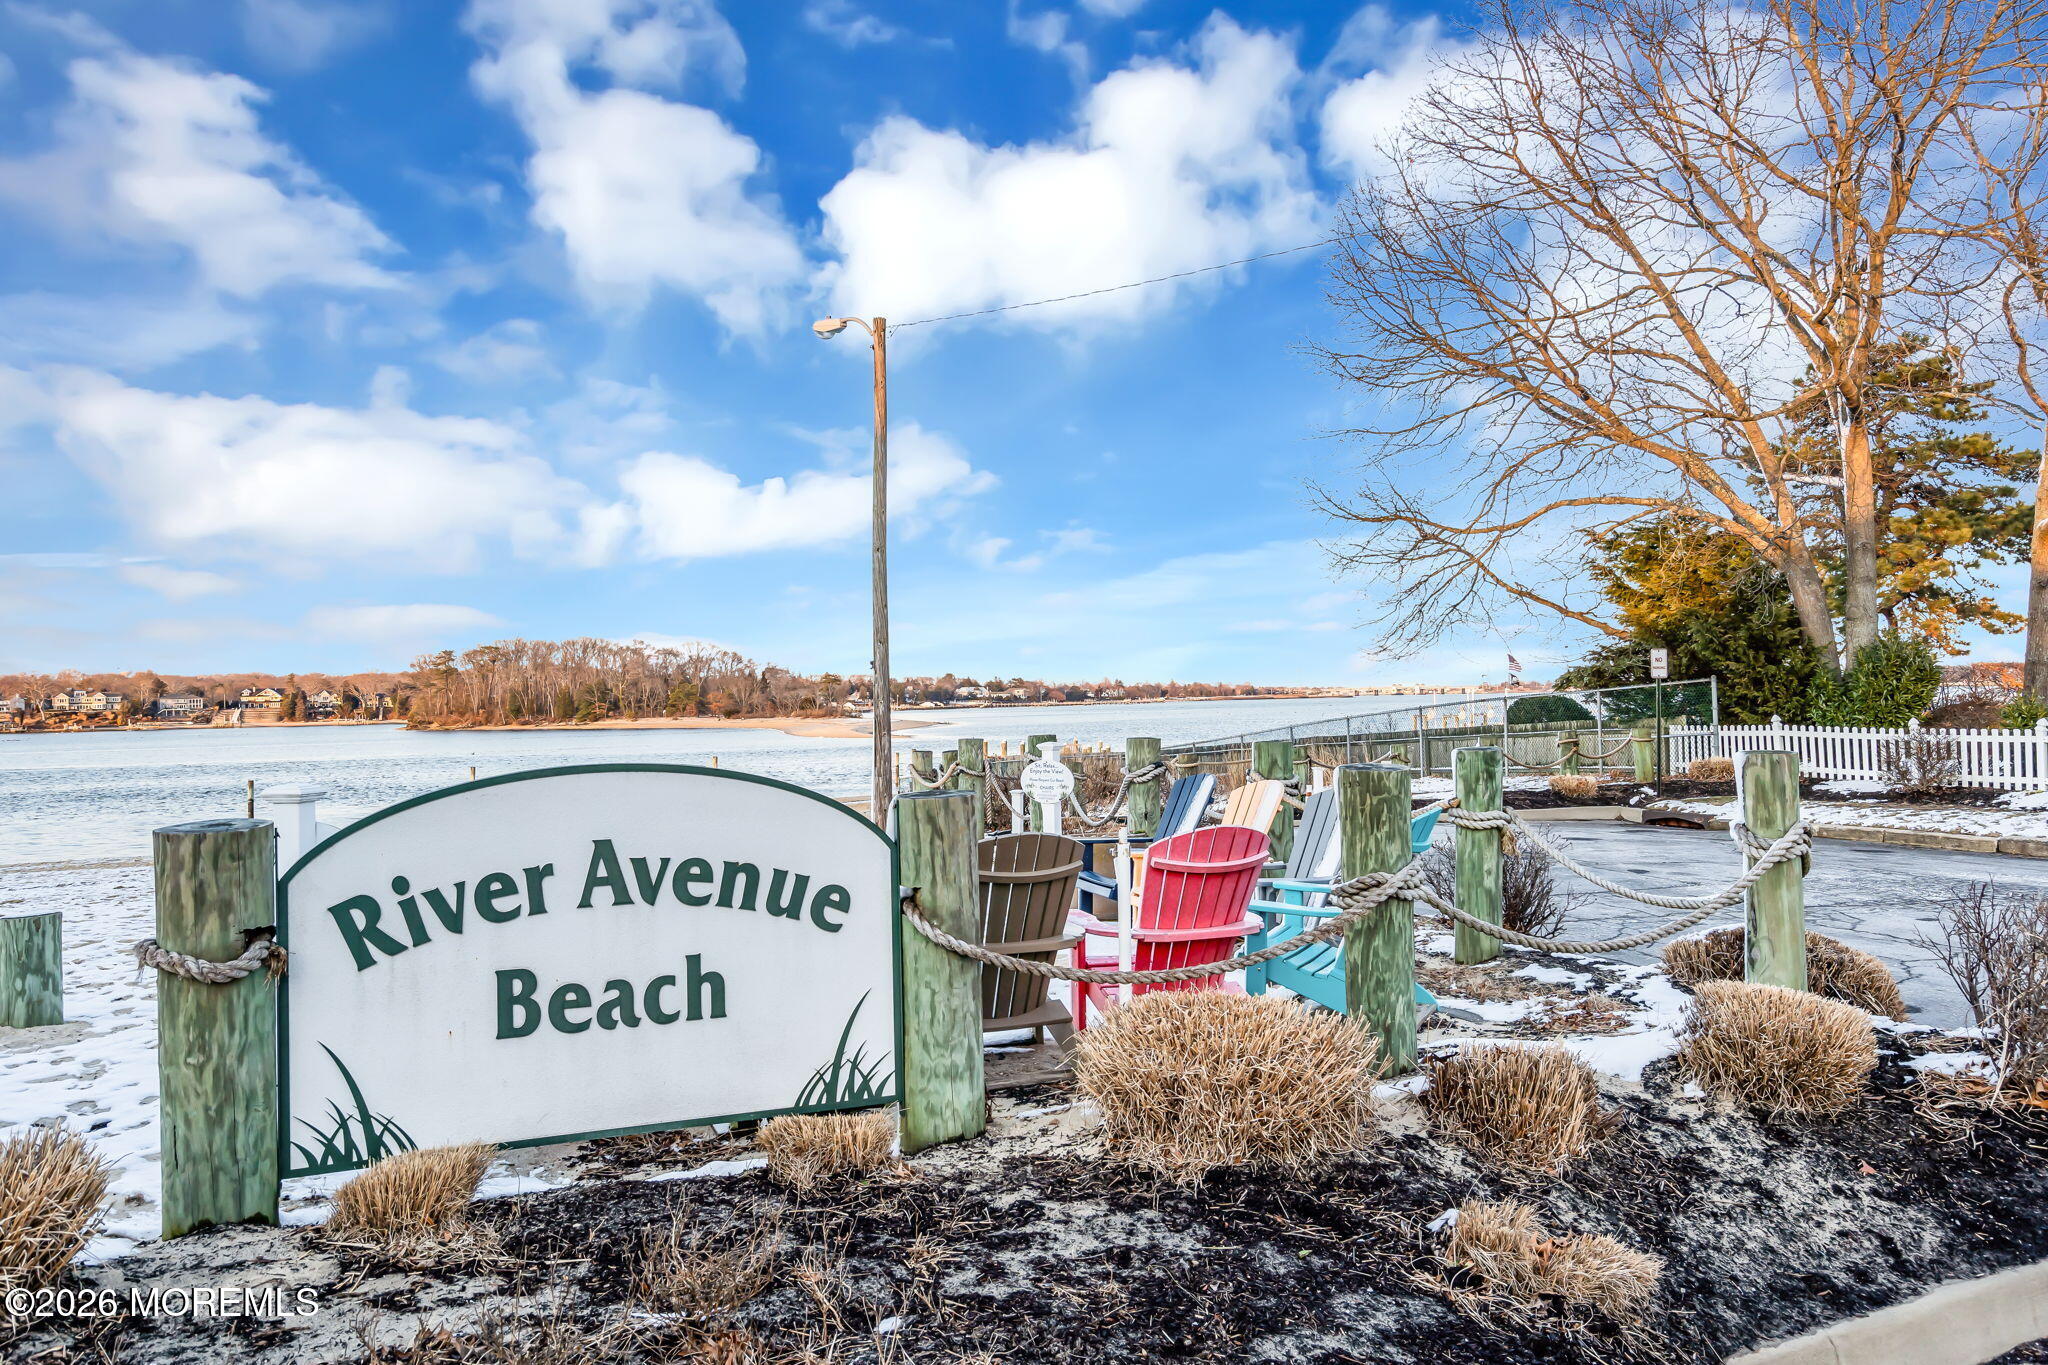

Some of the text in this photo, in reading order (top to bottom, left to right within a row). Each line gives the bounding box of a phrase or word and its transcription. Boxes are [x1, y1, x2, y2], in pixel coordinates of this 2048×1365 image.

[327, 838, 851, 972] River Avenue
[494, 953, 728, 1041] Beach
